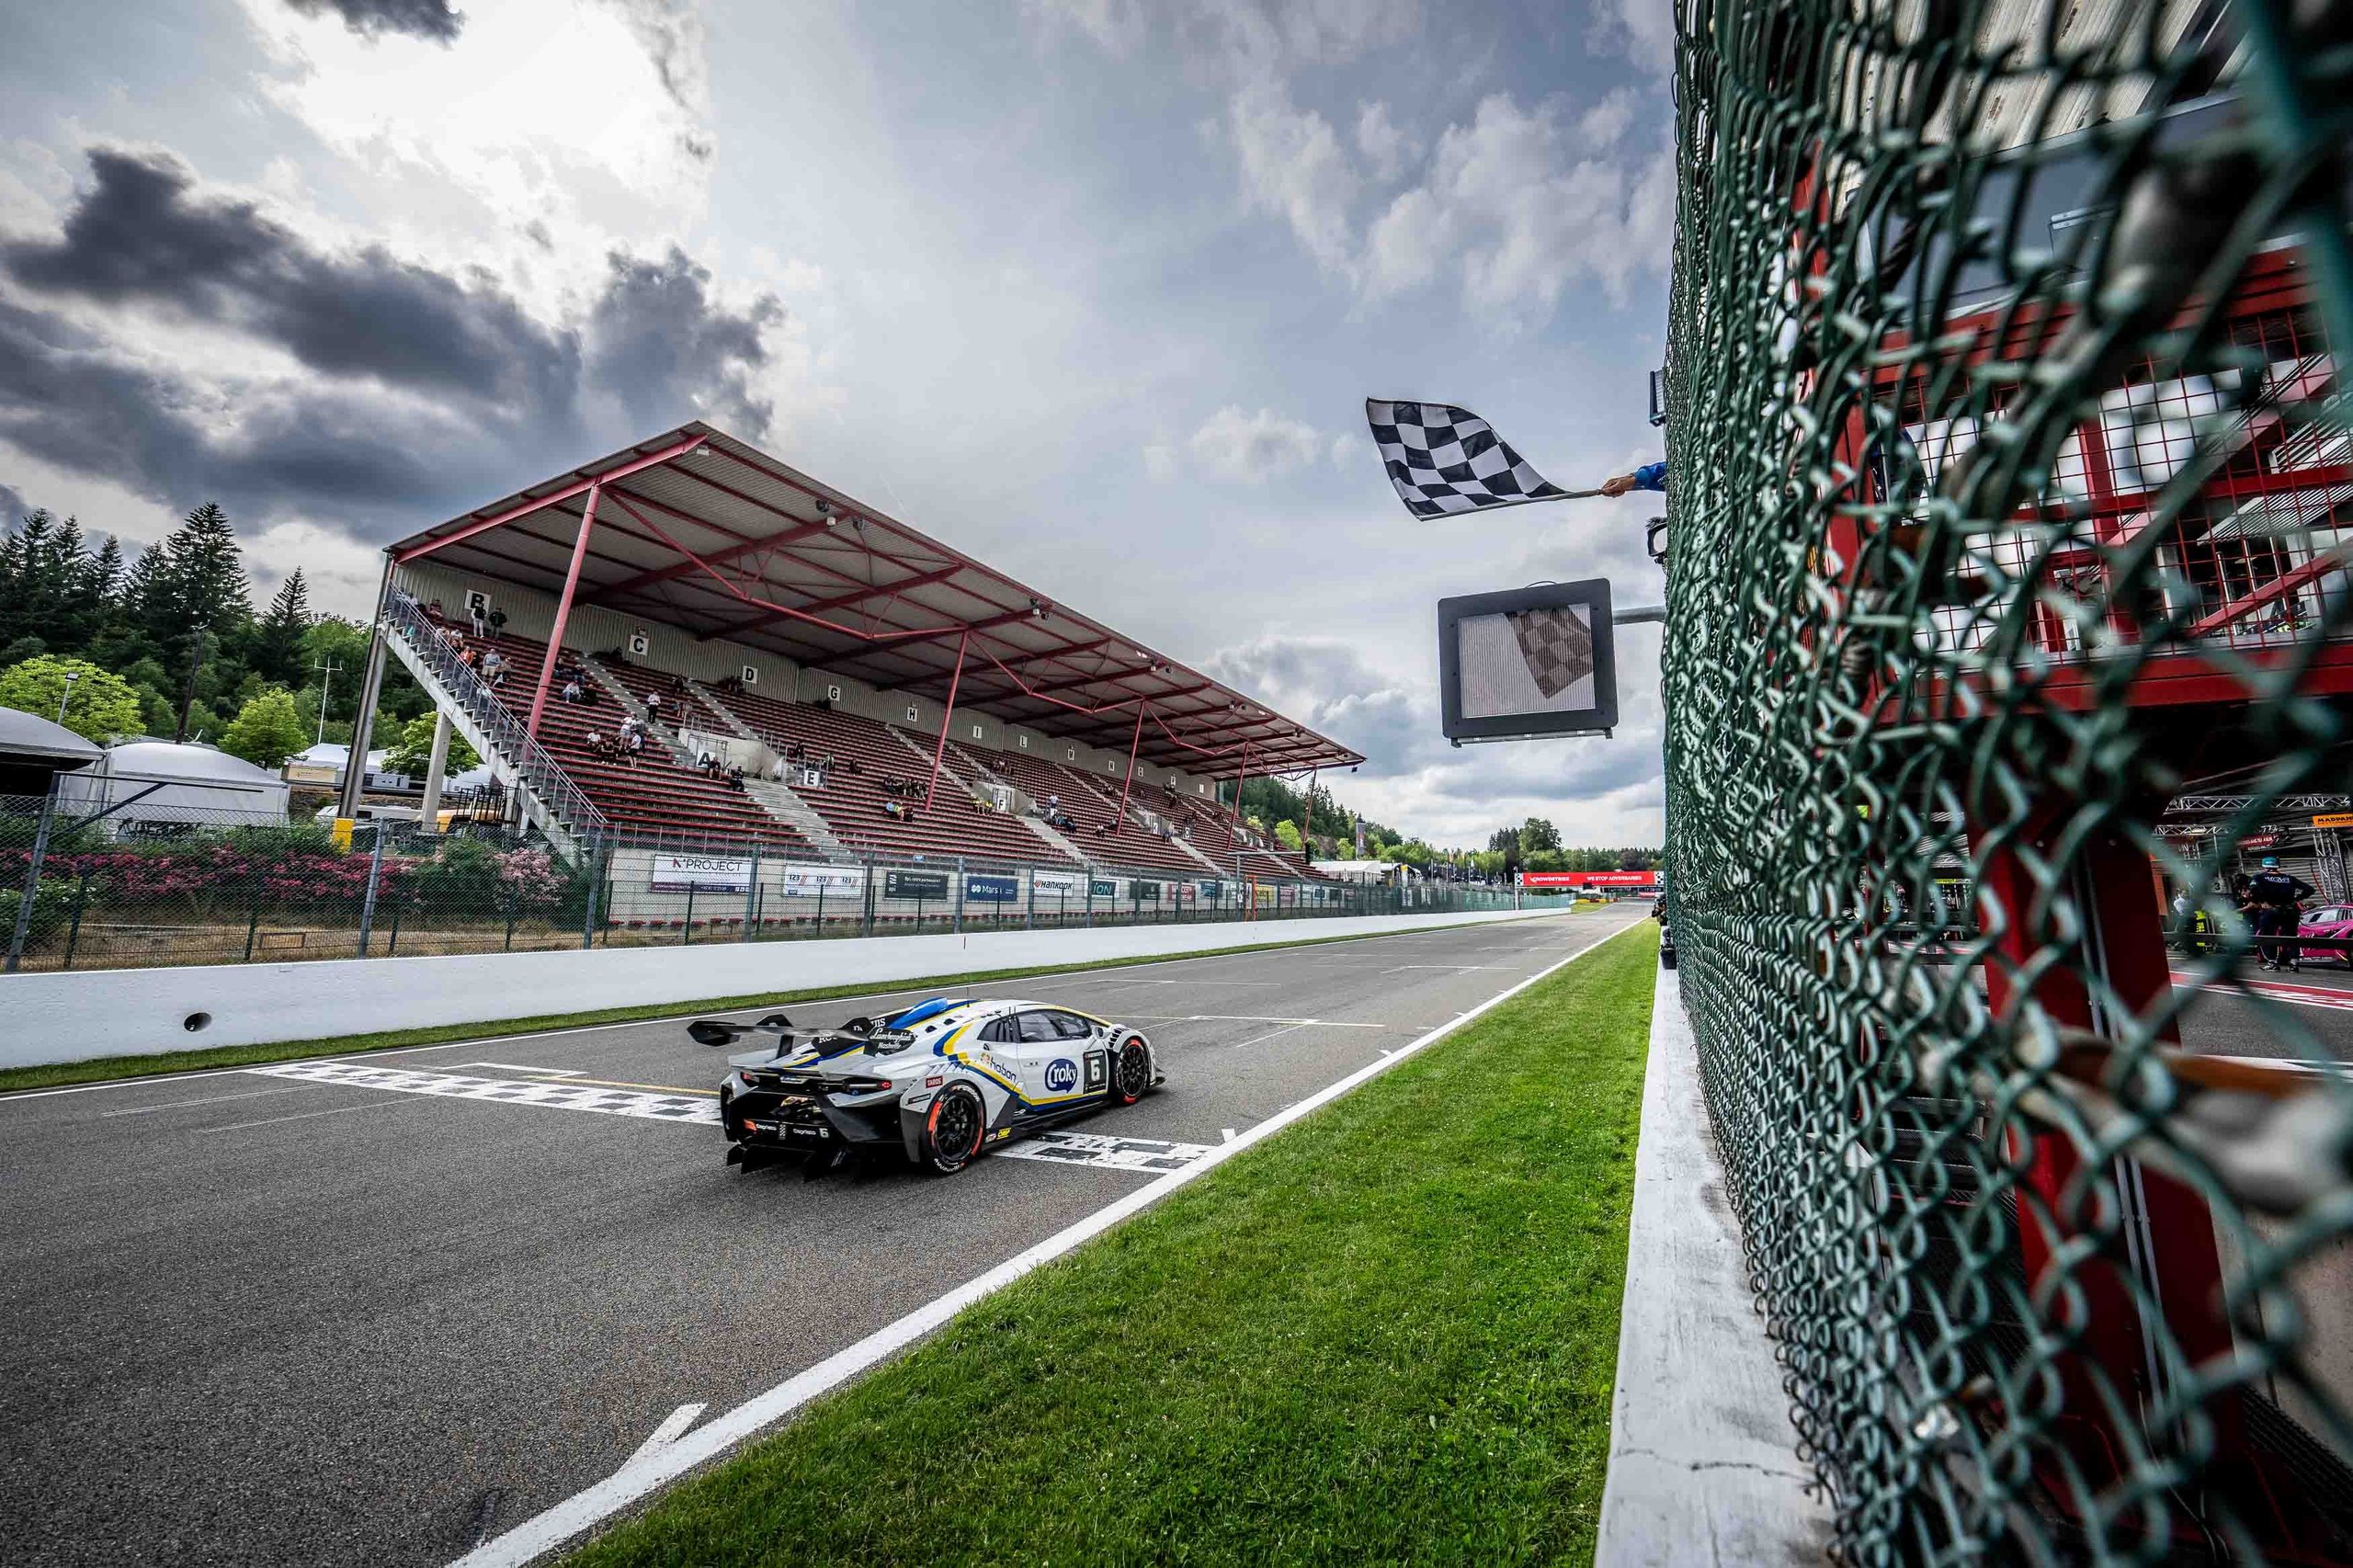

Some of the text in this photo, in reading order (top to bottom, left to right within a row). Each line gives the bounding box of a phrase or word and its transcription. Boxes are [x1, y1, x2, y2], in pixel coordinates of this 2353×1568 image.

[471, 593, 484, 608] B
[633, 638, 644, 653] C
[745, 667, 755, 680] D
[831, 687, 837, 699] G
[909, 709, 915, 720] H
[1021, 736, 1026, 746] L
[698, 752, 710, 766] A
[807, 772, 814, 785] E
[998, 799, 1004, 810] F
[1047, 1063, 1076, 1088] Croky
[1090, 1059, 1100, 1082] 6
[819, 1128, 829, 1138] 6
